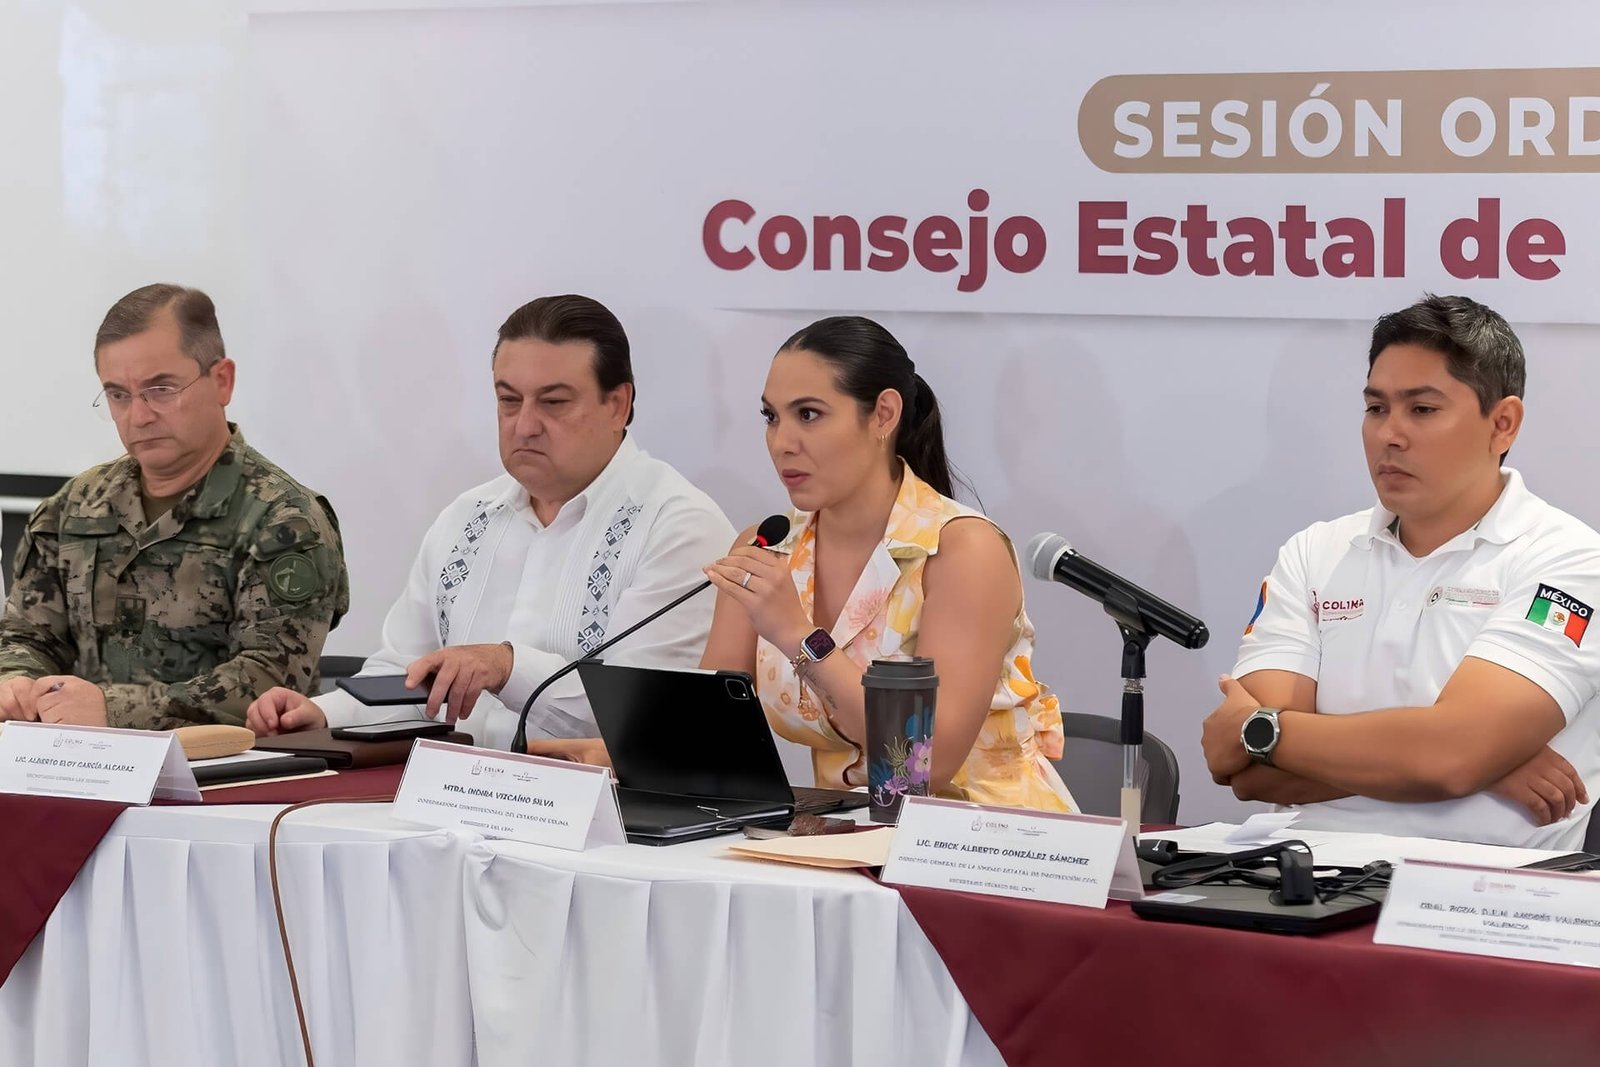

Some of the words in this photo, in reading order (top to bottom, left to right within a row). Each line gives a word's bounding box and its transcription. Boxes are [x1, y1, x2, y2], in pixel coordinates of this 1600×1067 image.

[1113, 83, 1403, 160] SESIÓN
[702, 188, 1047, 292] Consejo
[1079, 198, 1406, 278] Estatal
[1440, 198, 1567, 281] de
[1322, 598, 1364, 610] COLIMA
[1540, 588, 1588, 617] MÉXICO
[468, 788, 493, 798] INDIRA
[532, 798, 554, 808] SILVA
[960, 844, 1000, 855] ALBERTO
[1002, 849, 1047, 861] GONZÁLEZ
[1049, 853, 1089, 865] SÁNCHEZ
